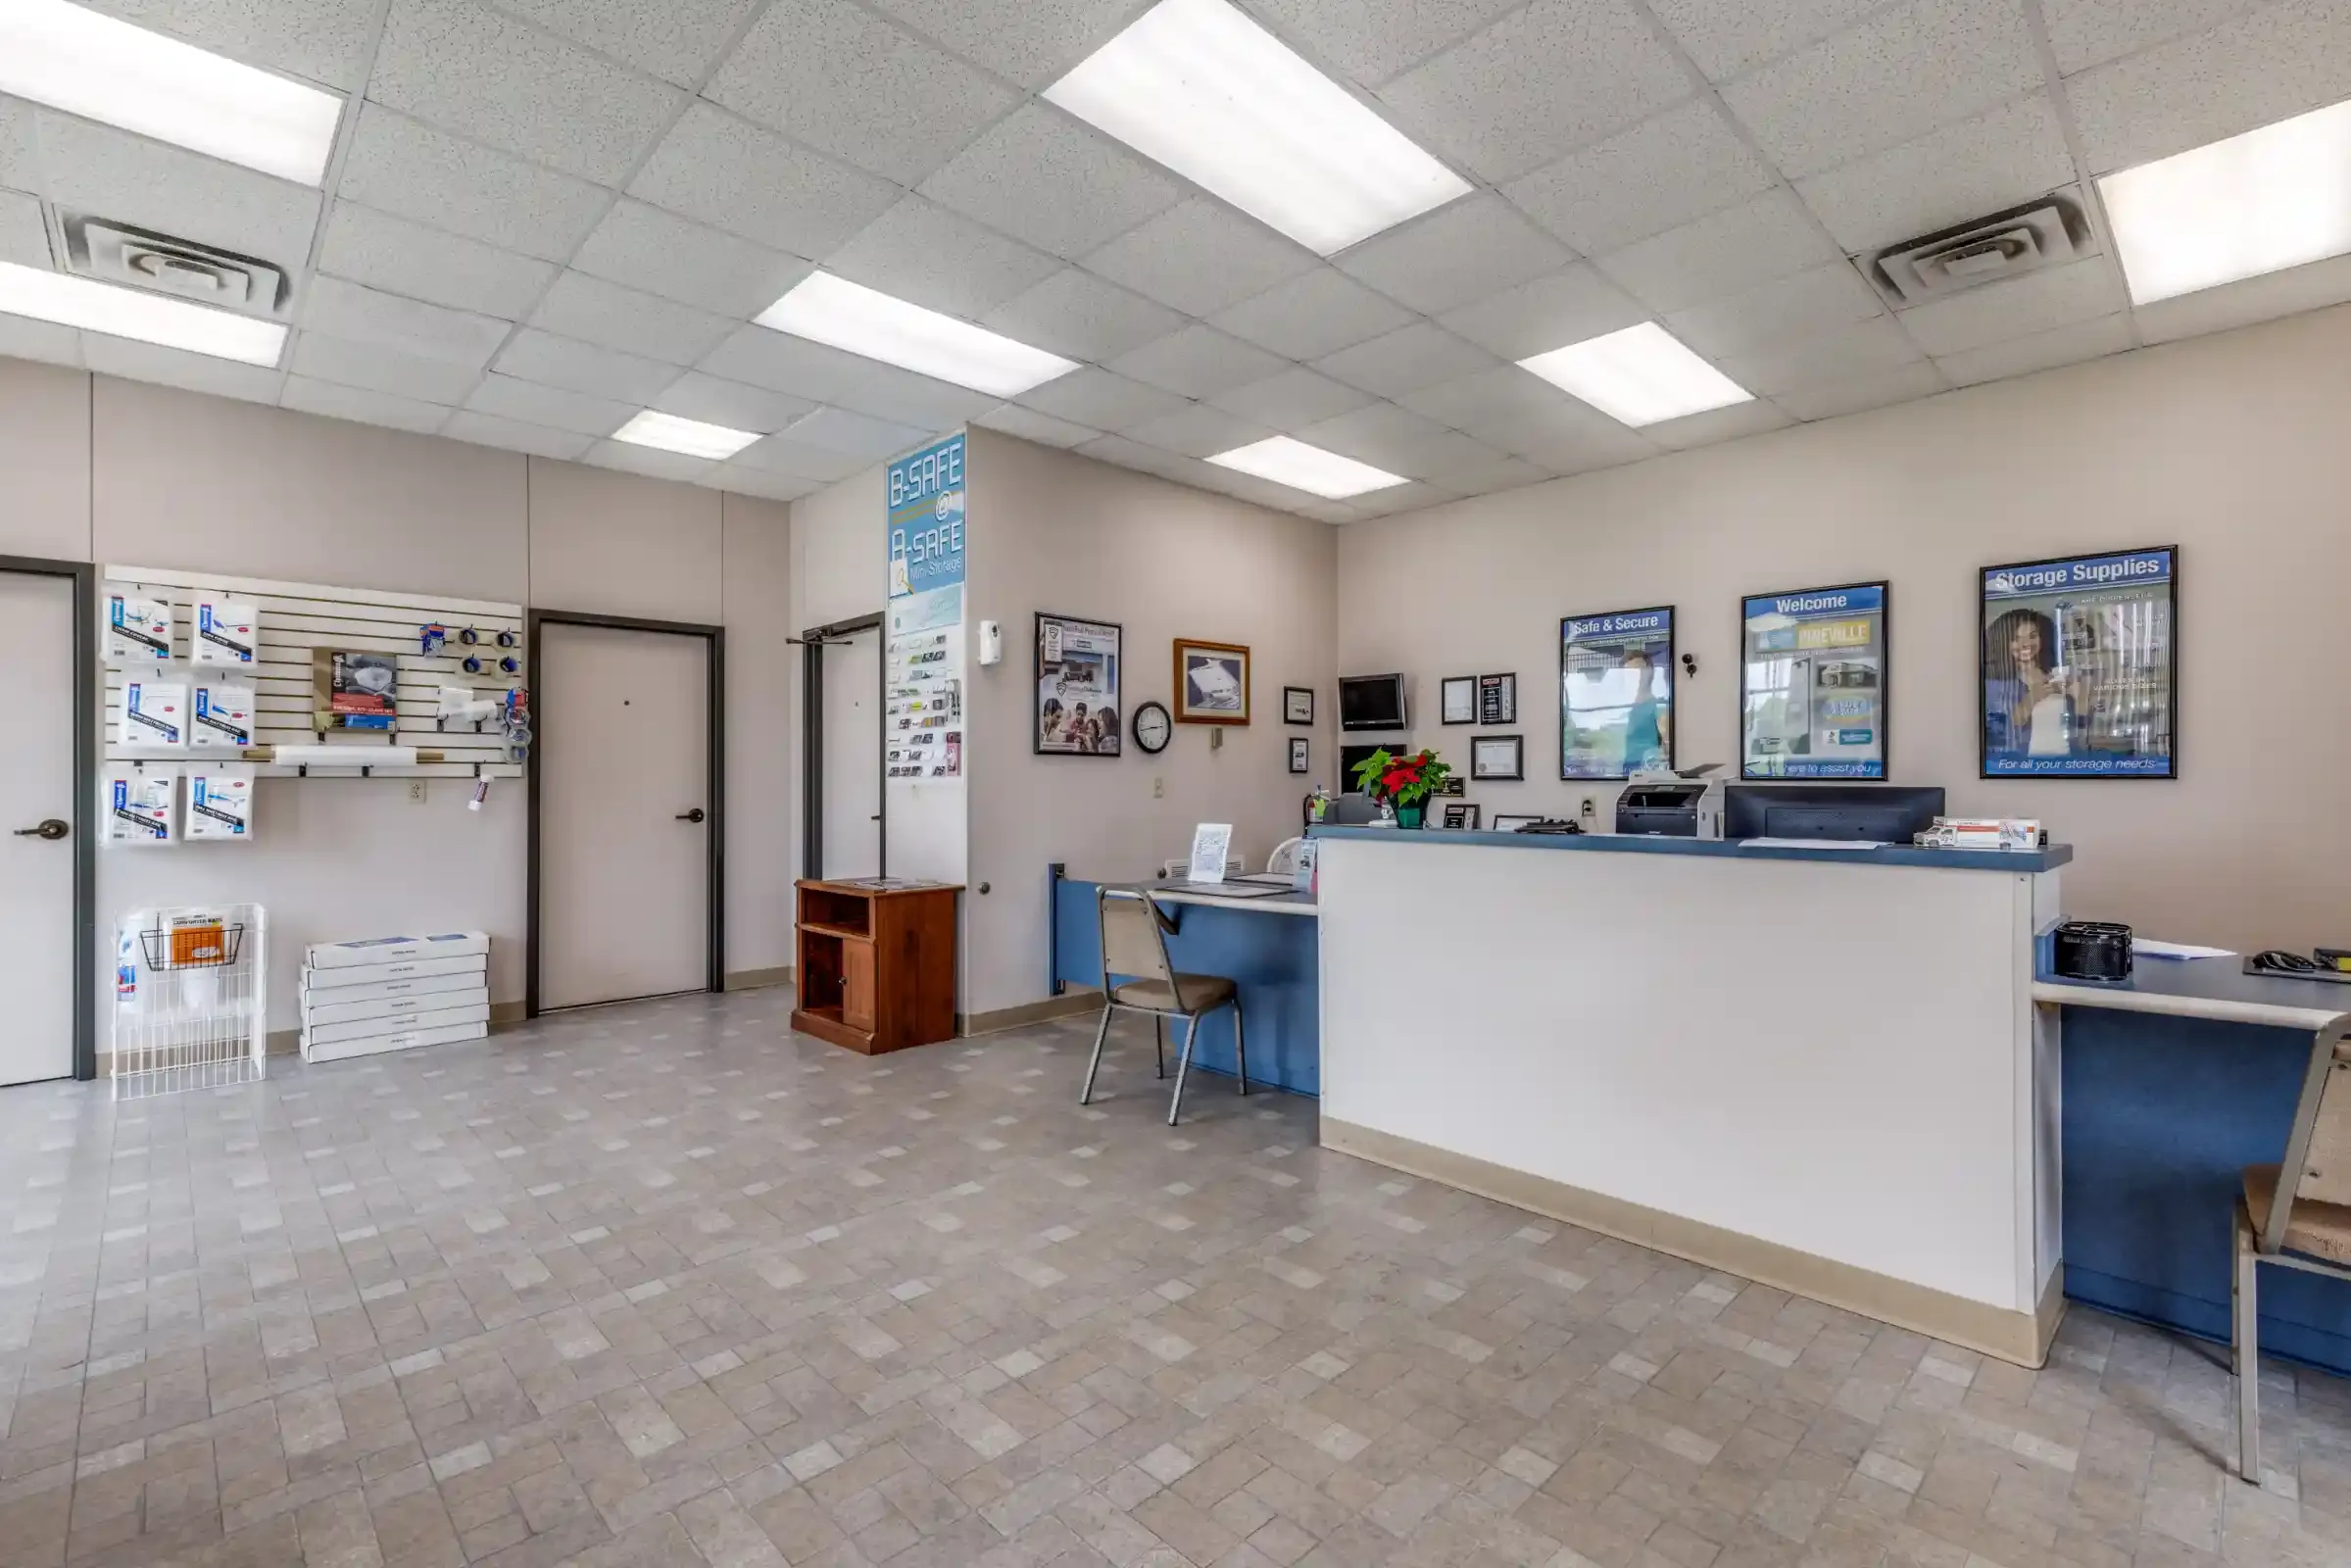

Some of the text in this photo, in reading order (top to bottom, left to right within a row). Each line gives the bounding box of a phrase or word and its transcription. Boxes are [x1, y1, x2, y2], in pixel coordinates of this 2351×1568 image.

[891, 443, 961, 508] B-SAFE
[892, 519, 962, 564] A-SAFE
[1995, 559, 2159, 588] Storage Supplies
[1777, 595, 1847, 612] Welcome
[1575, 615, 1658, 634] Safe & Secure
[1798, 624, 1866, 643] PINEVILLE
[1808, 763, 1818, 773] to
[1820, 763, 1847, 773] assist
[1850, 765, 1872, 776] you
[1998, 759, 2156, 771] For all your storage needs
